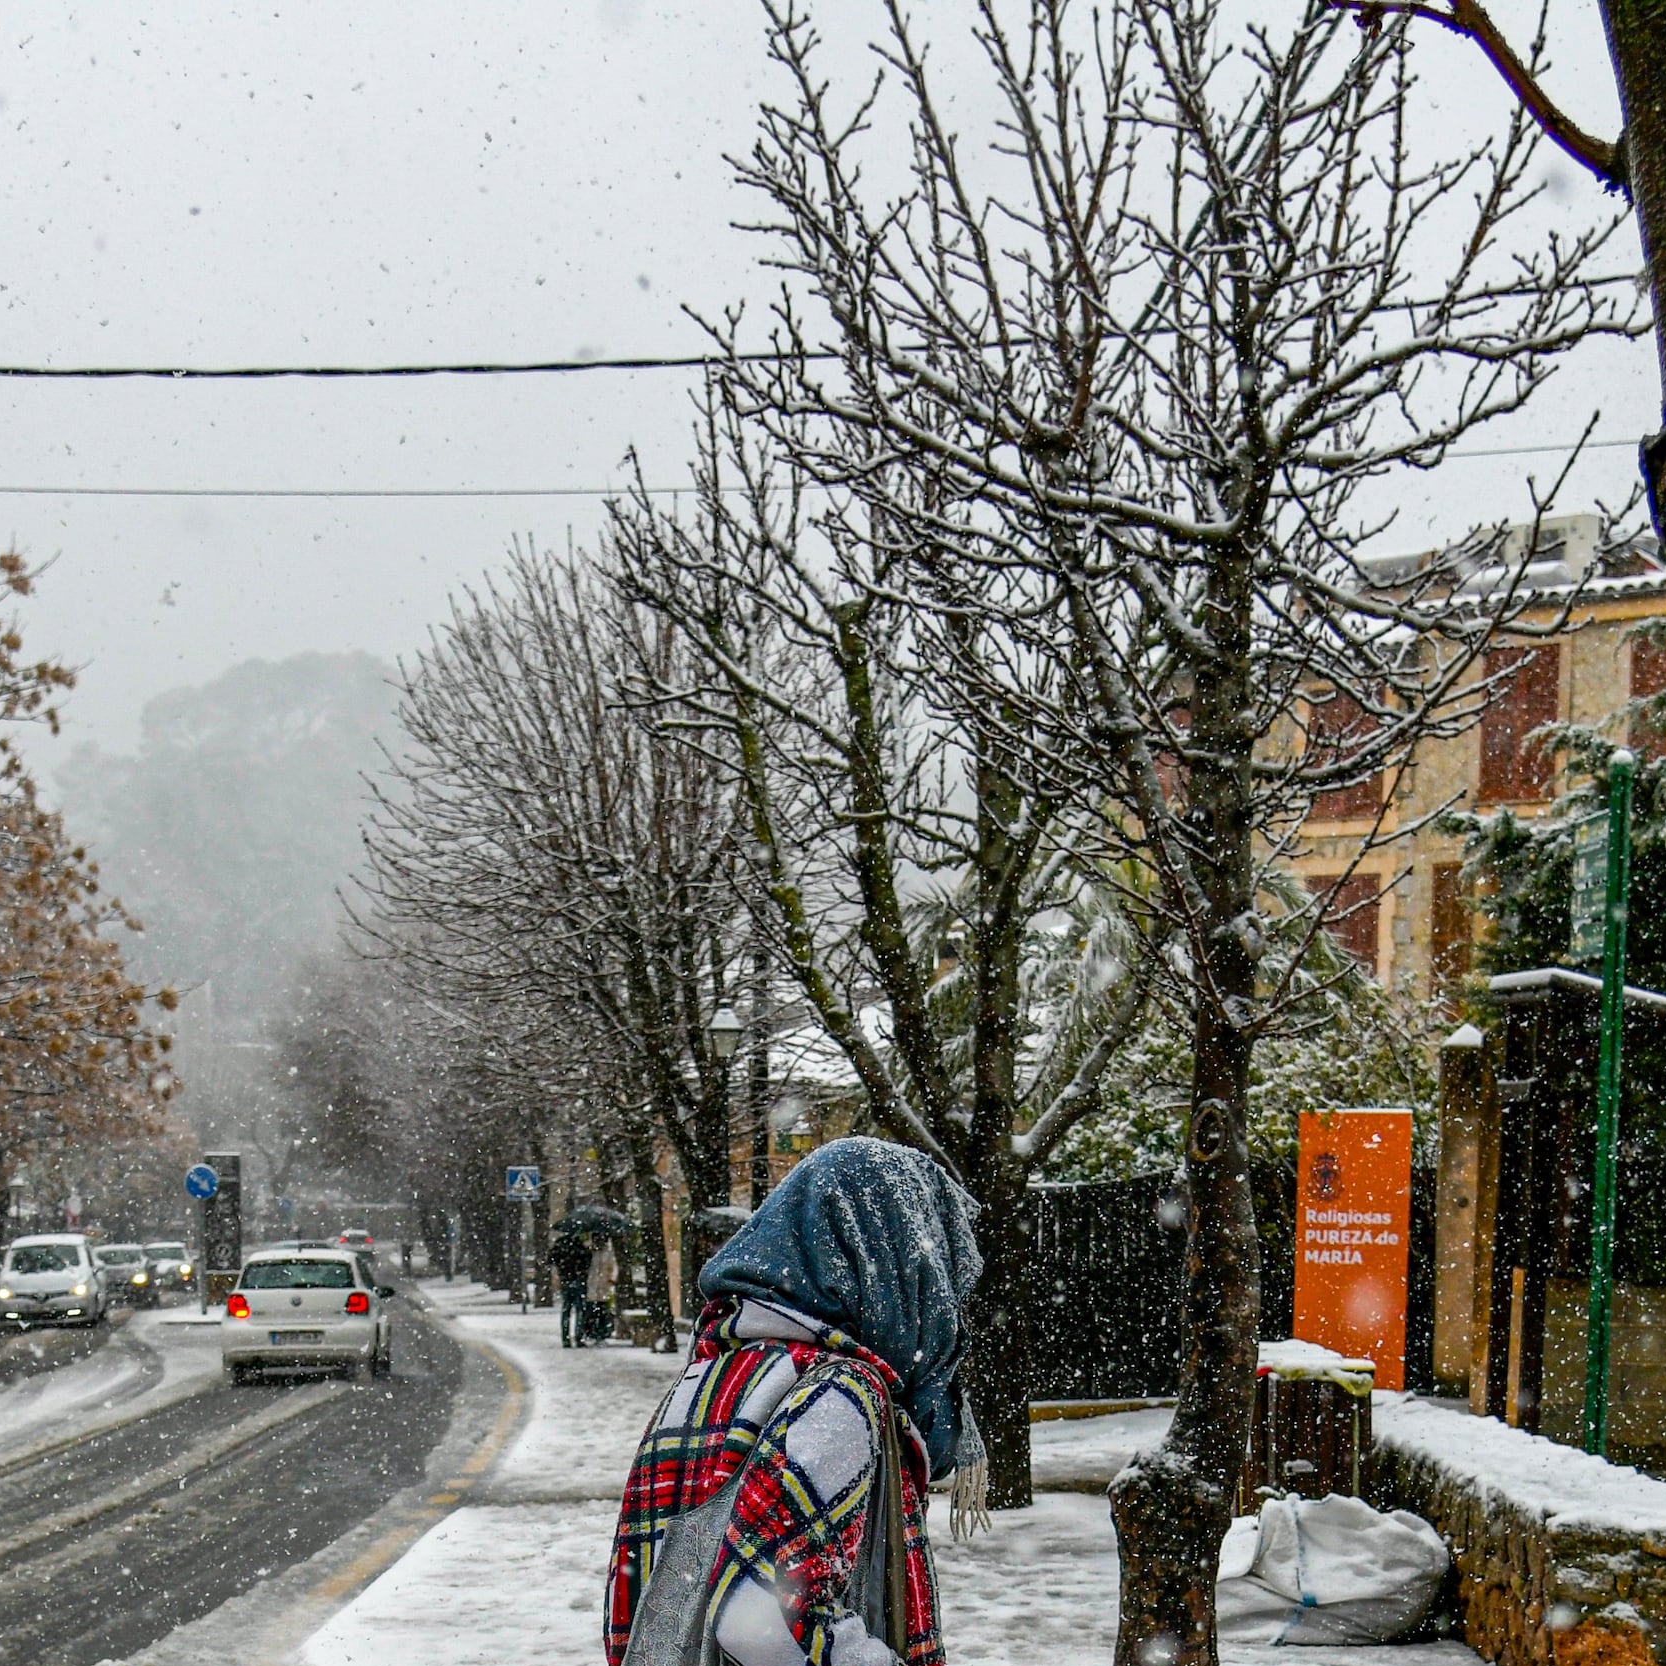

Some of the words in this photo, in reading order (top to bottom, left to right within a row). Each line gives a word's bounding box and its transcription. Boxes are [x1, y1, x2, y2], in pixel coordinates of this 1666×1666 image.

[1306, 1209, 1392, 1227] Religiosas
[1306, 1230, 1373, 1244] PUREZA
[1377, 1230, 1399, 1245] de
[1305, 1246, 1363, 1264] MARÍA
